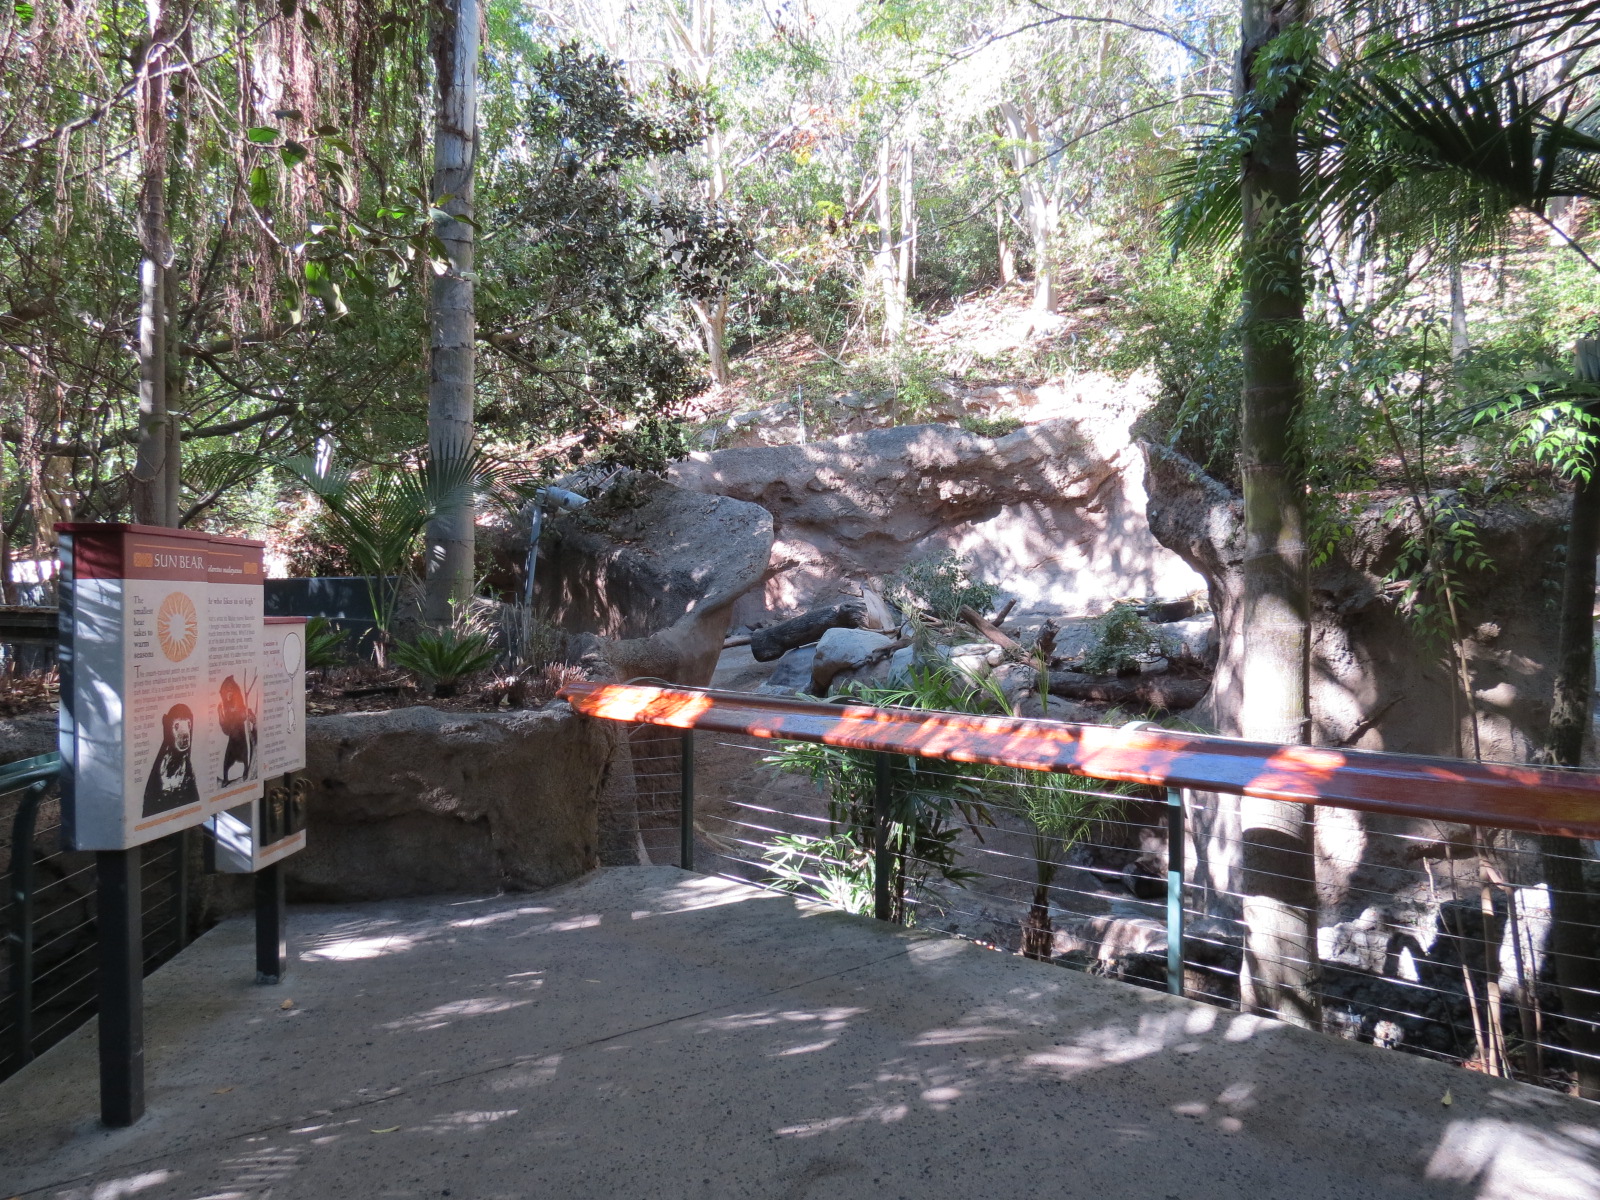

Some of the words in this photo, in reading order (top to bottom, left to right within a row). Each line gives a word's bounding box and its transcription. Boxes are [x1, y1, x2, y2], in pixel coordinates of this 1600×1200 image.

[154, 553, 178, 568] SUN
[179, 554, 205, 570] BEAR
[133, 595, 144, 604] The
